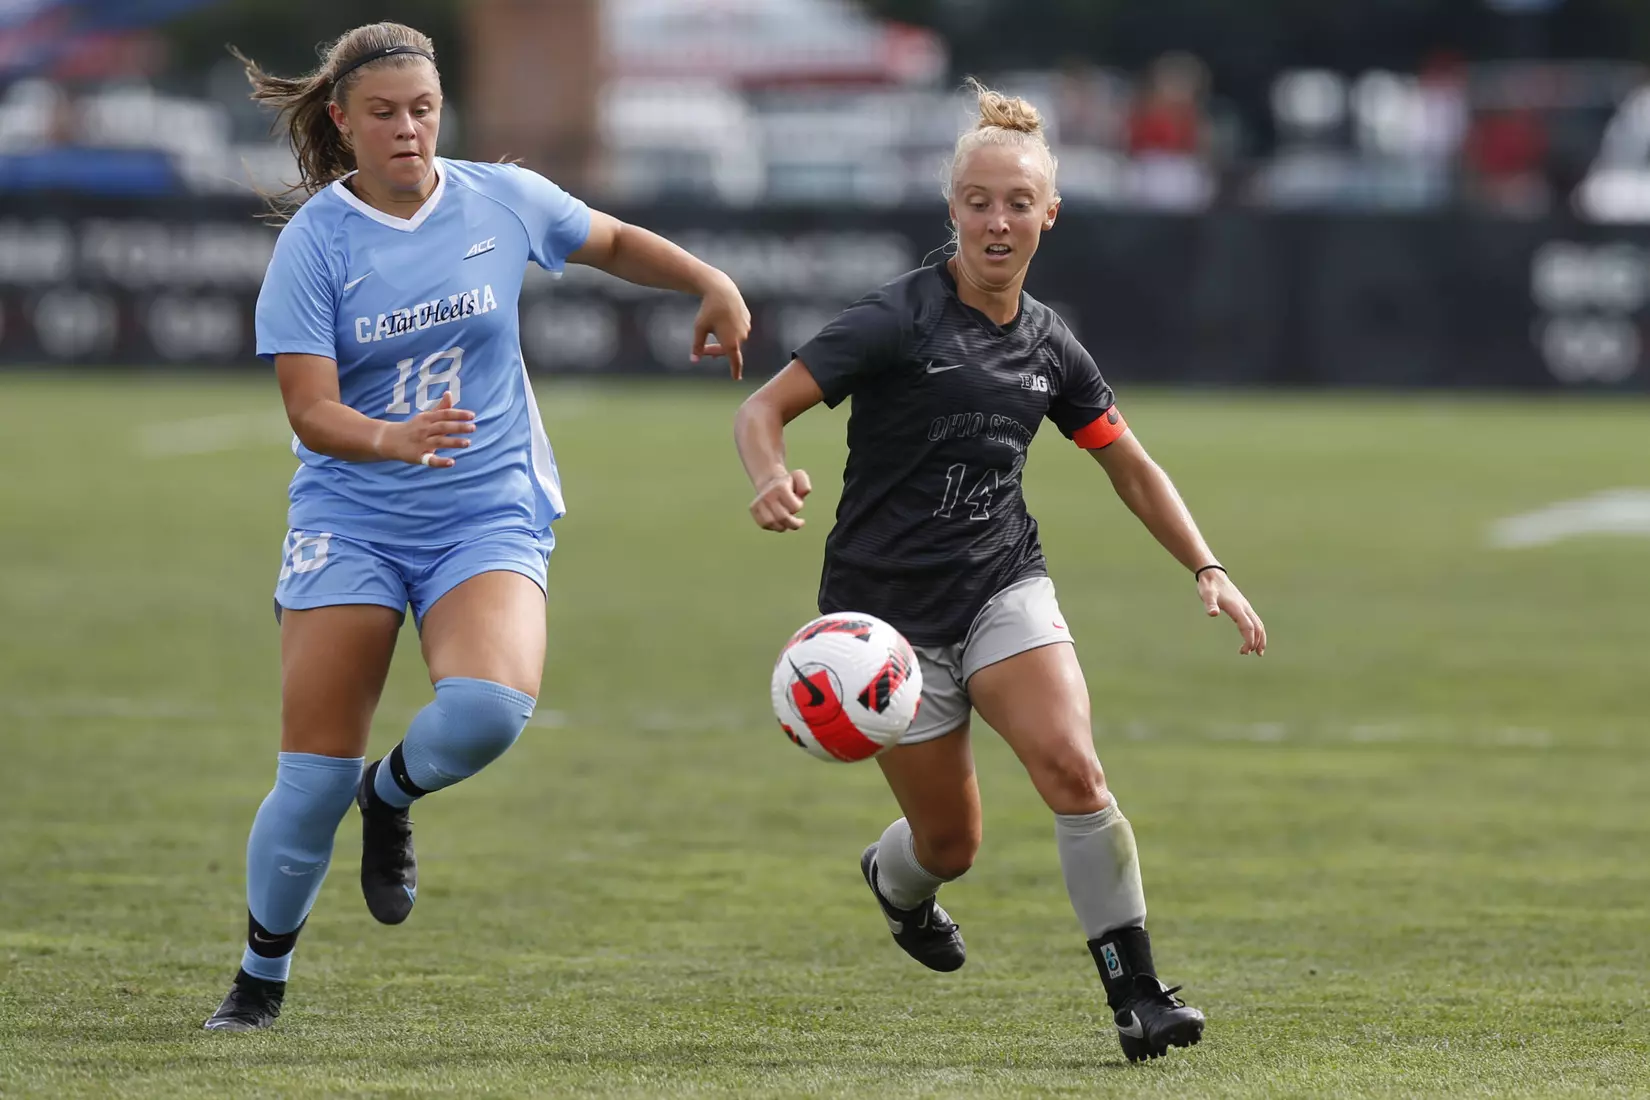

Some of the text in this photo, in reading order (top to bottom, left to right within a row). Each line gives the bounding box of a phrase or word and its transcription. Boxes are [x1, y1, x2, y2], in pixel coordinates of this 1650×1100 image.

[466, 237, 495, 258] ACC
[355, 284, 497, 343] CAROLINA
[382, 293, 476, 335] Tar Heels
[385, 346, 465, 414] 18
[928, 412, 1033, 452] OHIO STAT
[933, 462, 999, 520] 14
